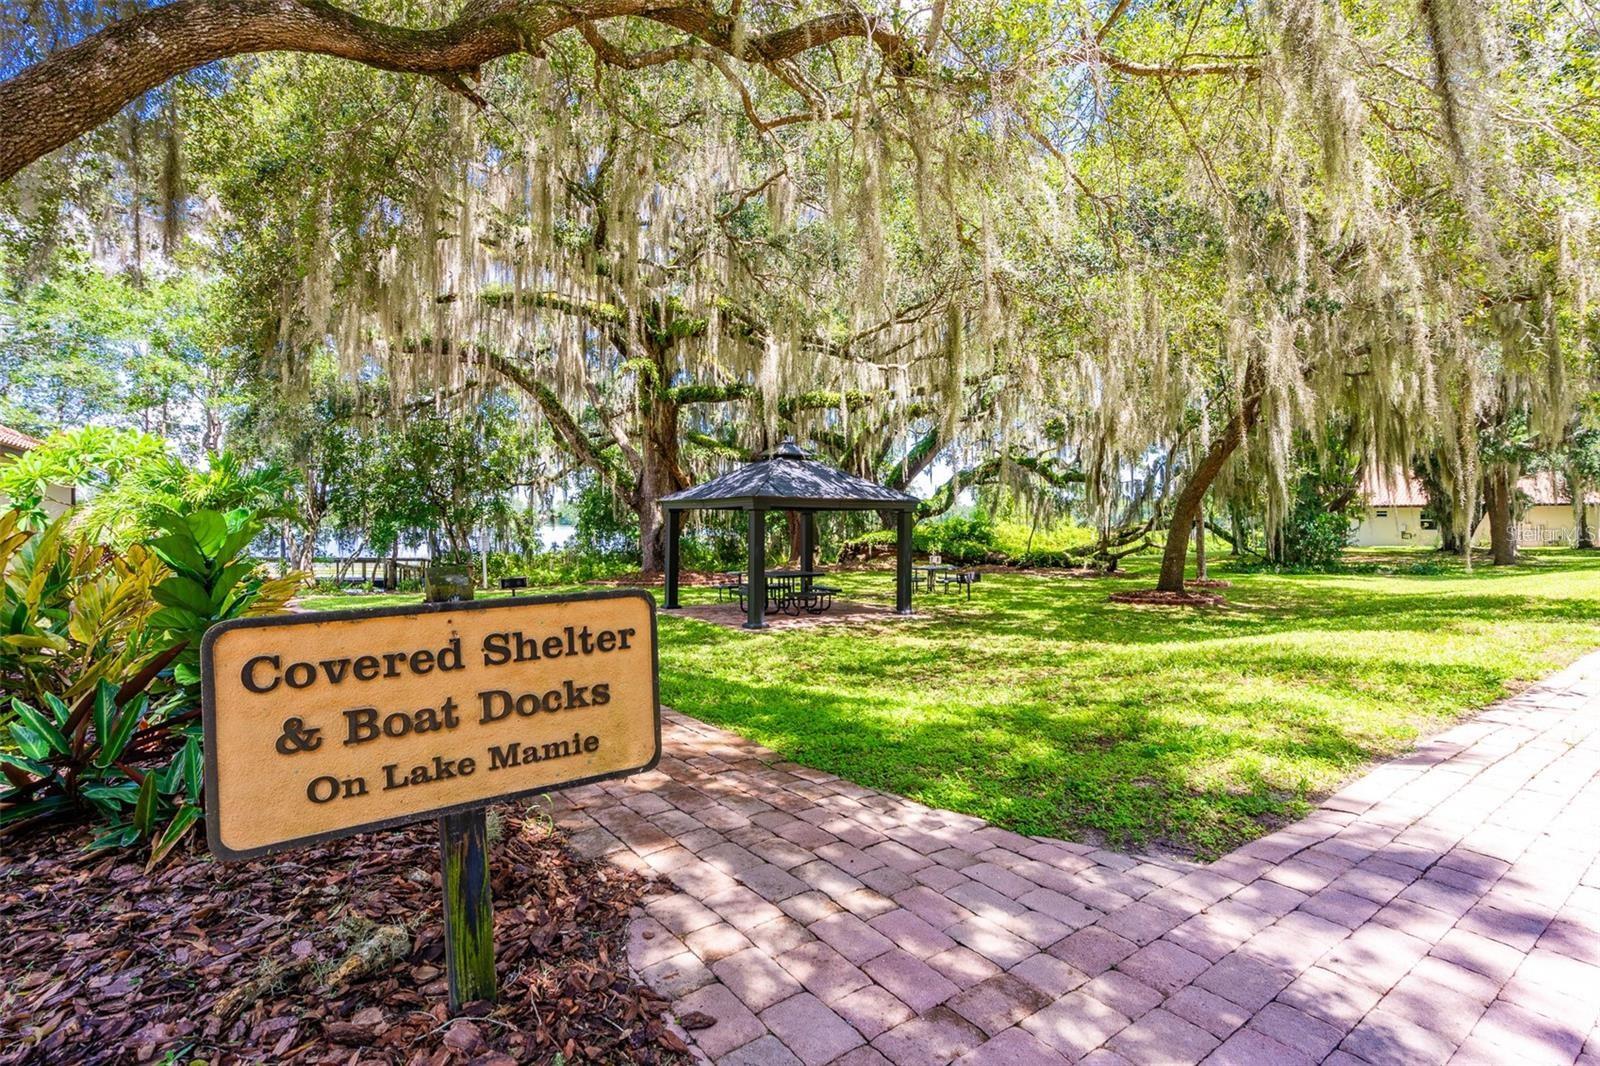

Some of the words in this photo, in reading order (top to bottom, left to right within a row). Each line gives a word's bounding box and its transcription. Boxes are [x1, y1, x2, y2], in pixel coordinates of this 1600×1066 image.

[241, 637, 465, 693] Covered
[483, 626, 636, 667] Shelter
[275, 717, 322, 755] &
[343, 697, 460, 746] Boat
[478, 680, 611, 725] Docks
[307, 775, 369, 804] On
[382, 756, 476, 791] Lake
[488, 733, 600, 773] Mamie
